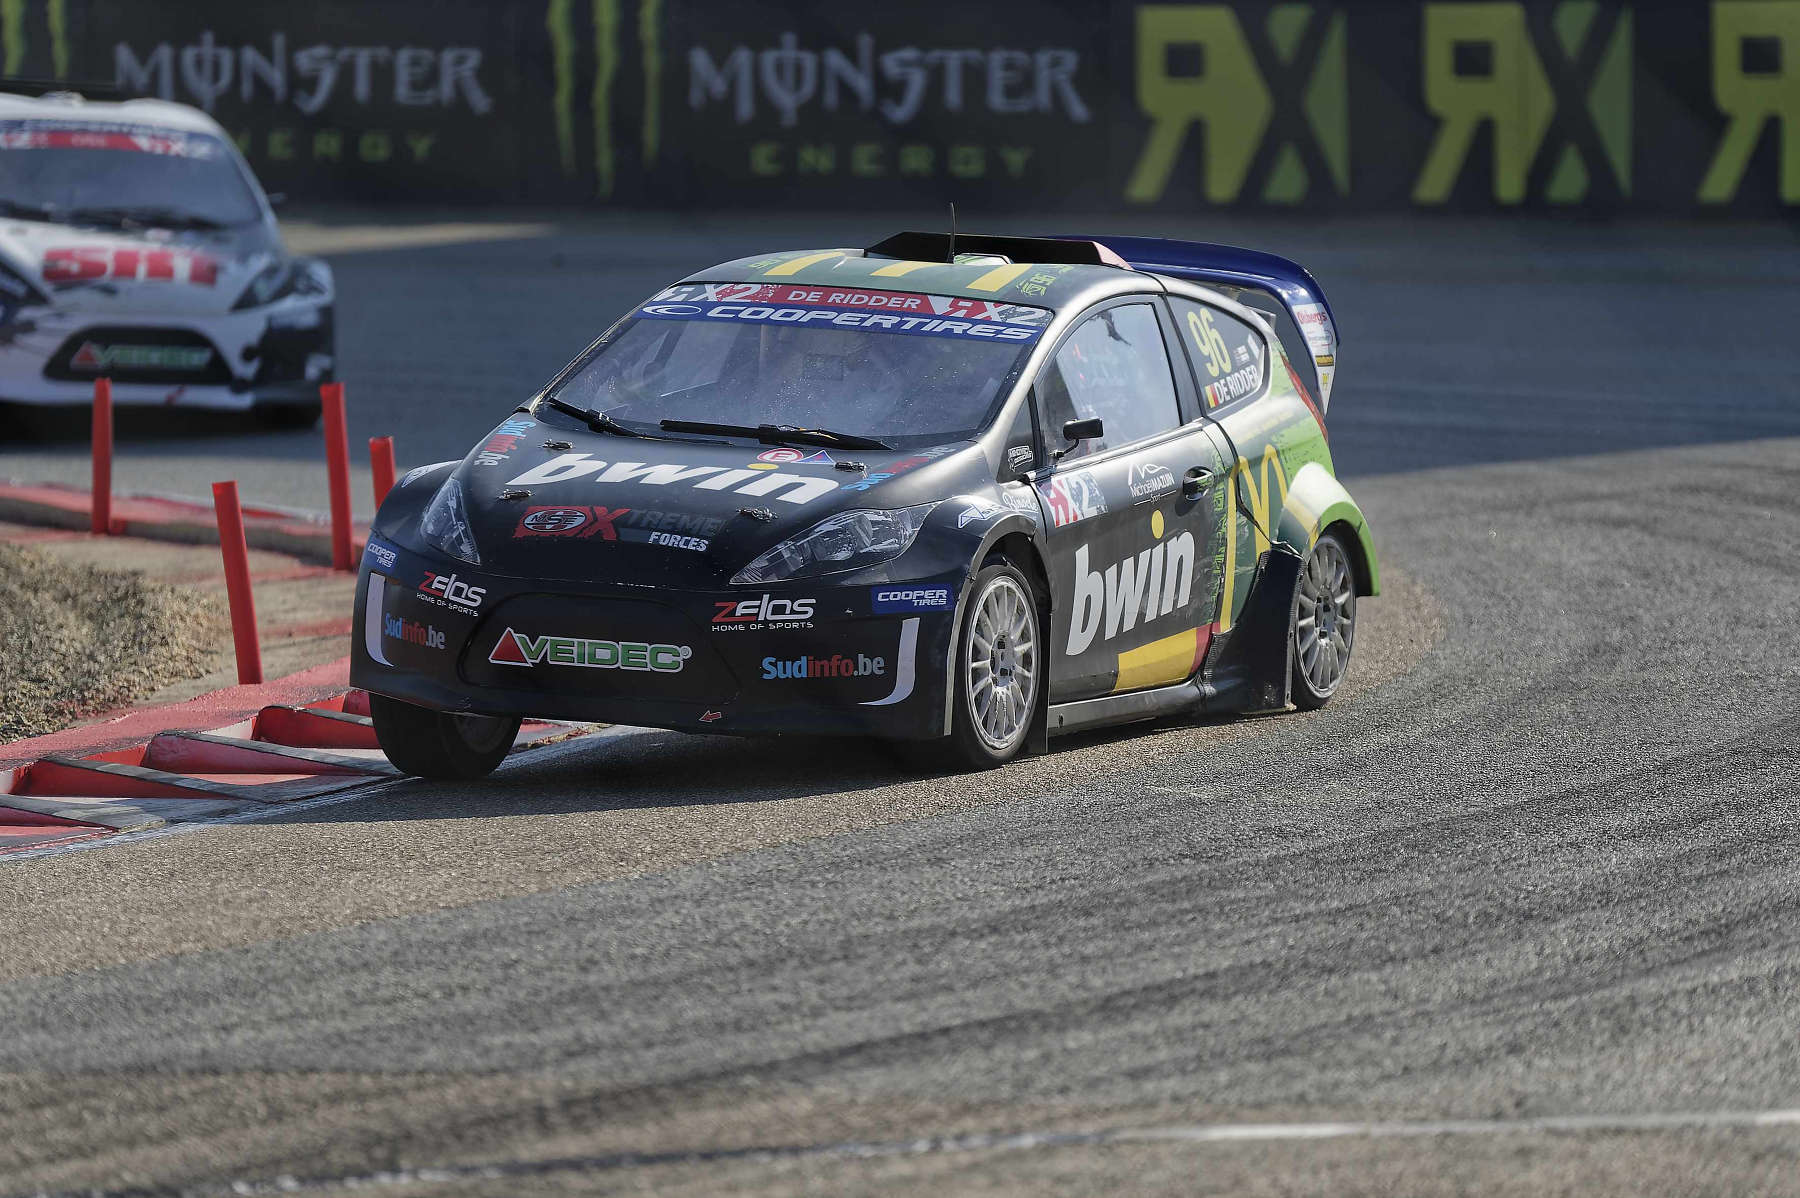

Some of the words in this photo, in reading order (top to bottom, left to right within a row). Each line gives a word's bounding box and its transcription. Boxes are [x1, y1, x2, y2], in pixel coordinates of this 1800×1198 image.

[113, 30, 493, 115] MONSTER
[686, 31, 1092, 126] MONSTER
[240, 130, 438, 162] ERGY
[750, 142, 1034, 178] ENERGY
[787, 290, 822, 303] DE
[827, 293, 922, 310] RIDDER
[1186, 307, 1232, 377] 96
[1214, 378, 1230, 404] DE
[1225, 364, 1259, 399] RIDDER
[505, 453, 840, 505] bwin
[367, 543, 397, 561] COOPER
[648, 531, 709, 552] FORCES
[376, 556, 393, 568] TIRES
[877, 588, 948, 602] COOPER
[1066, 509, 1195, 656] bwin
[416, 592, 435, 604] HOME
[448, 603, 479, 617] SPORTS
[911, 598, 947, 607] TIRES
[384, 612, 446, 650] Sudinfo.be
[711, 622, 745, 632] HOME
[749, 622, 765, 631] OF
[768, 621, 814, 630] SPORTS
[761, 653, 886, 680] Sudinfo.be
